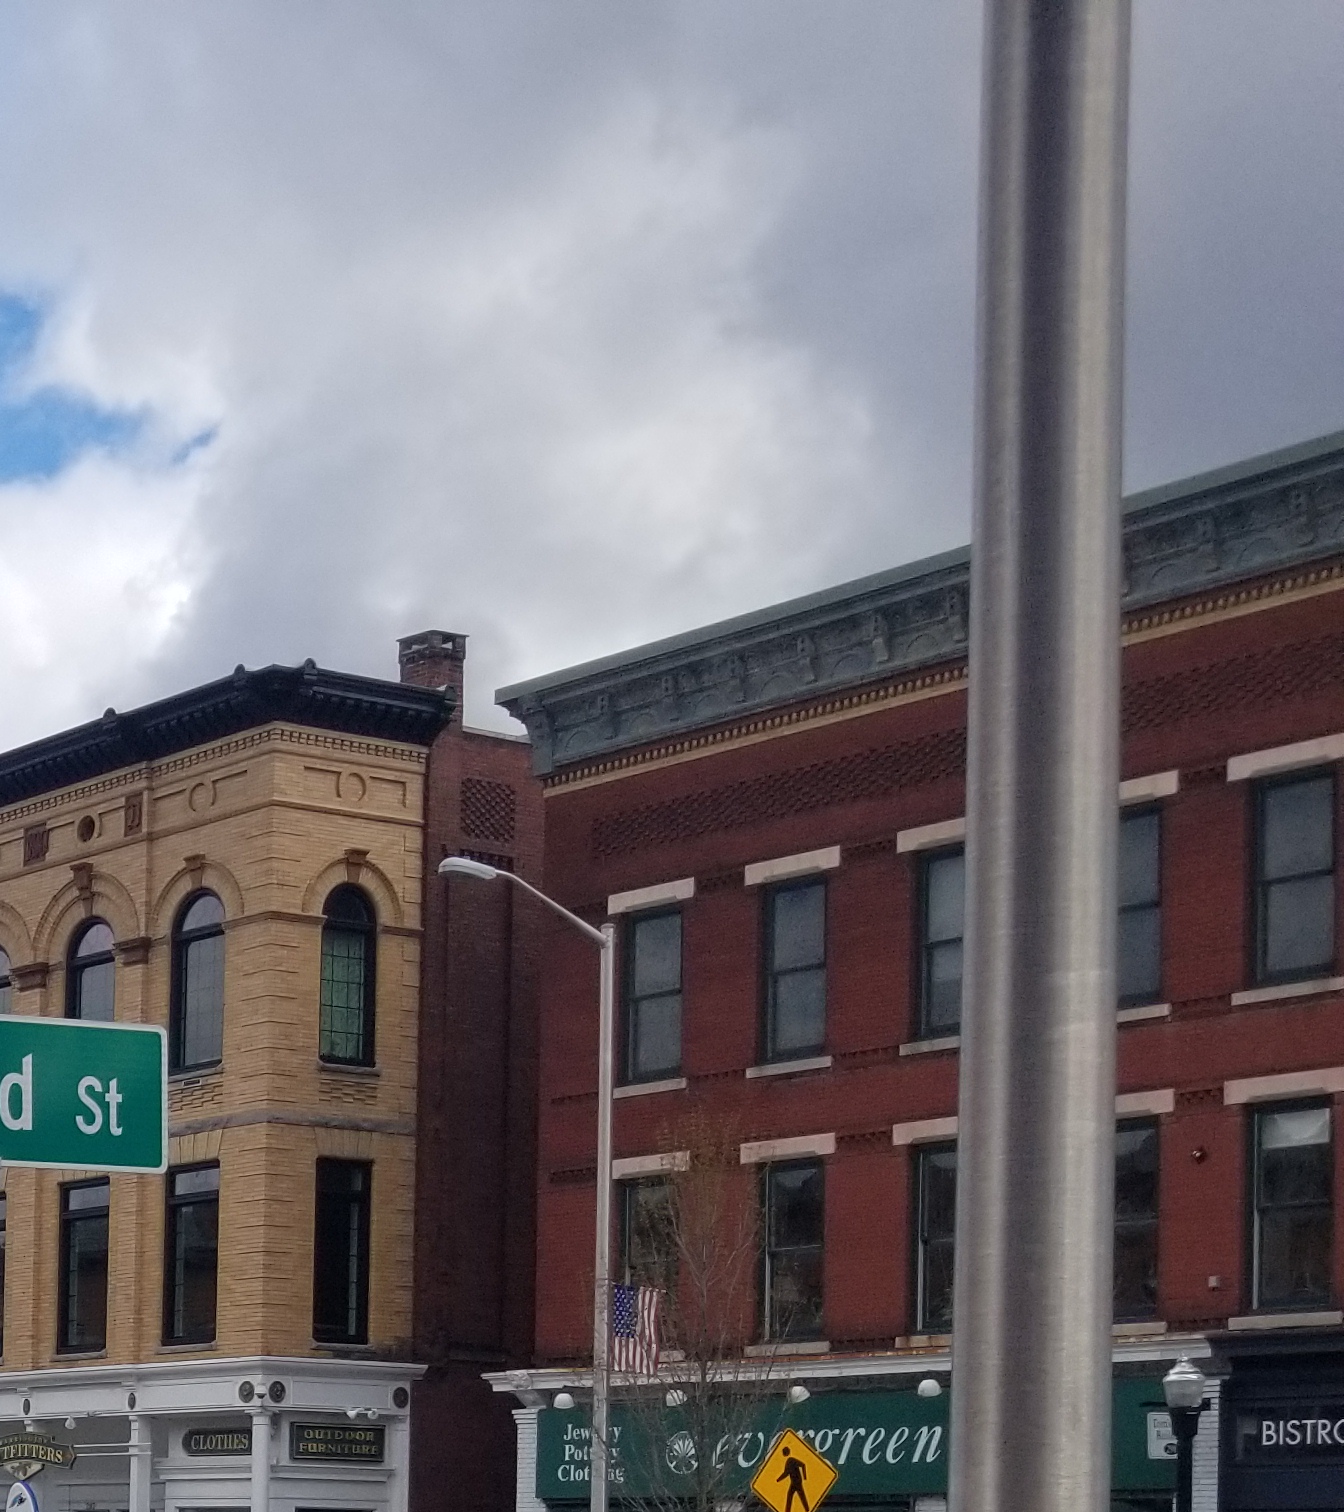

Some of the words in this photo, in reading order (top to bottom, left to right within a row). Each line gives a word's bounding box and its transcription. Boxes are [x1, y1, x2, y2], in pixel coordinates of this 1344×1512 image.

[75, 1075, 123, 1137] St
[190, 1433, 249, 1450] CLOTHES
[303, 1429, 375, 1442] OUTDOOR
[298, 1442, 379, 1455] FURNITURE
